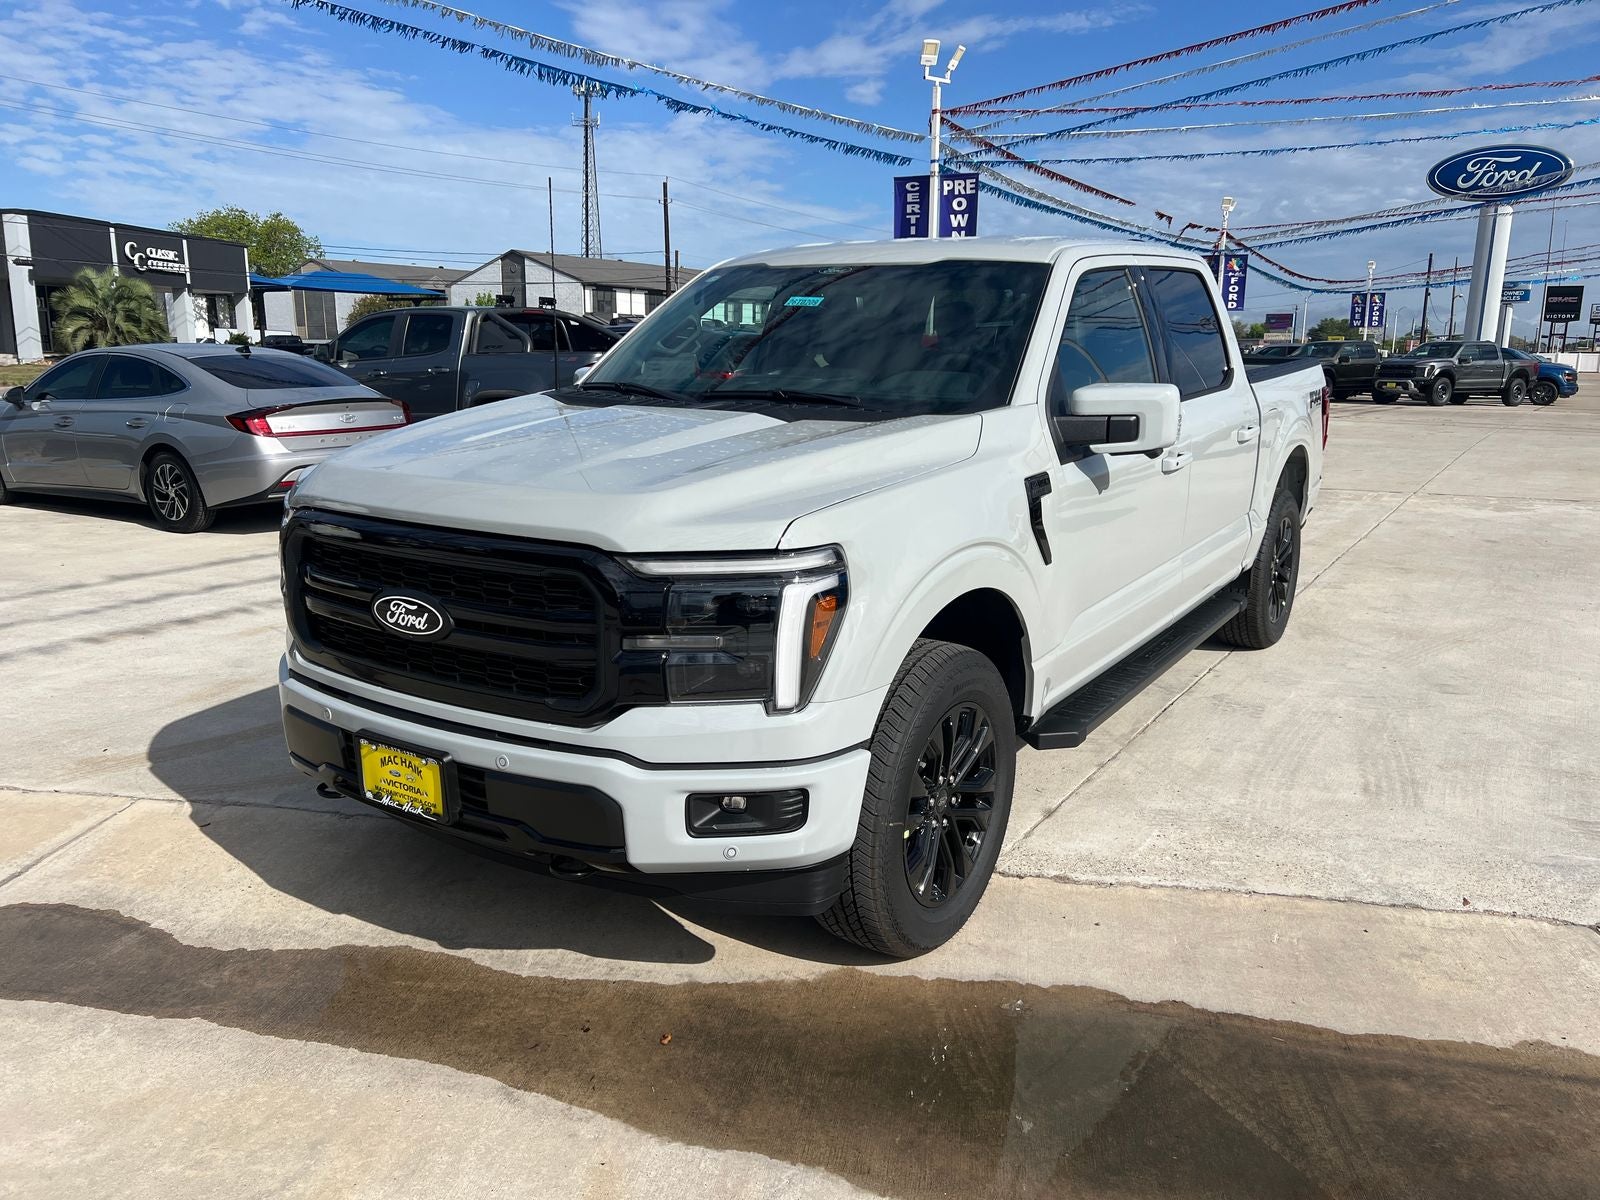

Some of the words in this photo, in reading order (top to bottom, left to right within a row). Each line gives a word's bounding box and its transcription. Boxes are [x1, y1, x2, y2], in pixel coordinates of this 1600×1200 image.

[1457, 156, 1542, 189] Ford
[943, 179, 976, 195] PRE
[905, 182, 920, 235] CERTI
[146, 247, 179, 261] CLASSIC
[1227, 277, 1239, 309] FORD
[1353, 306, 1362, 327] NEW
[1371, 306, 1380, 327] FORD
[386, 600, 429, 630] Ford
[380, 756, 399, 768] MAC
[401, 758, 423, 780] HAIK
[385, 778, 421, 795] VICTORIA
[380, 794, 401, 809] Mac
